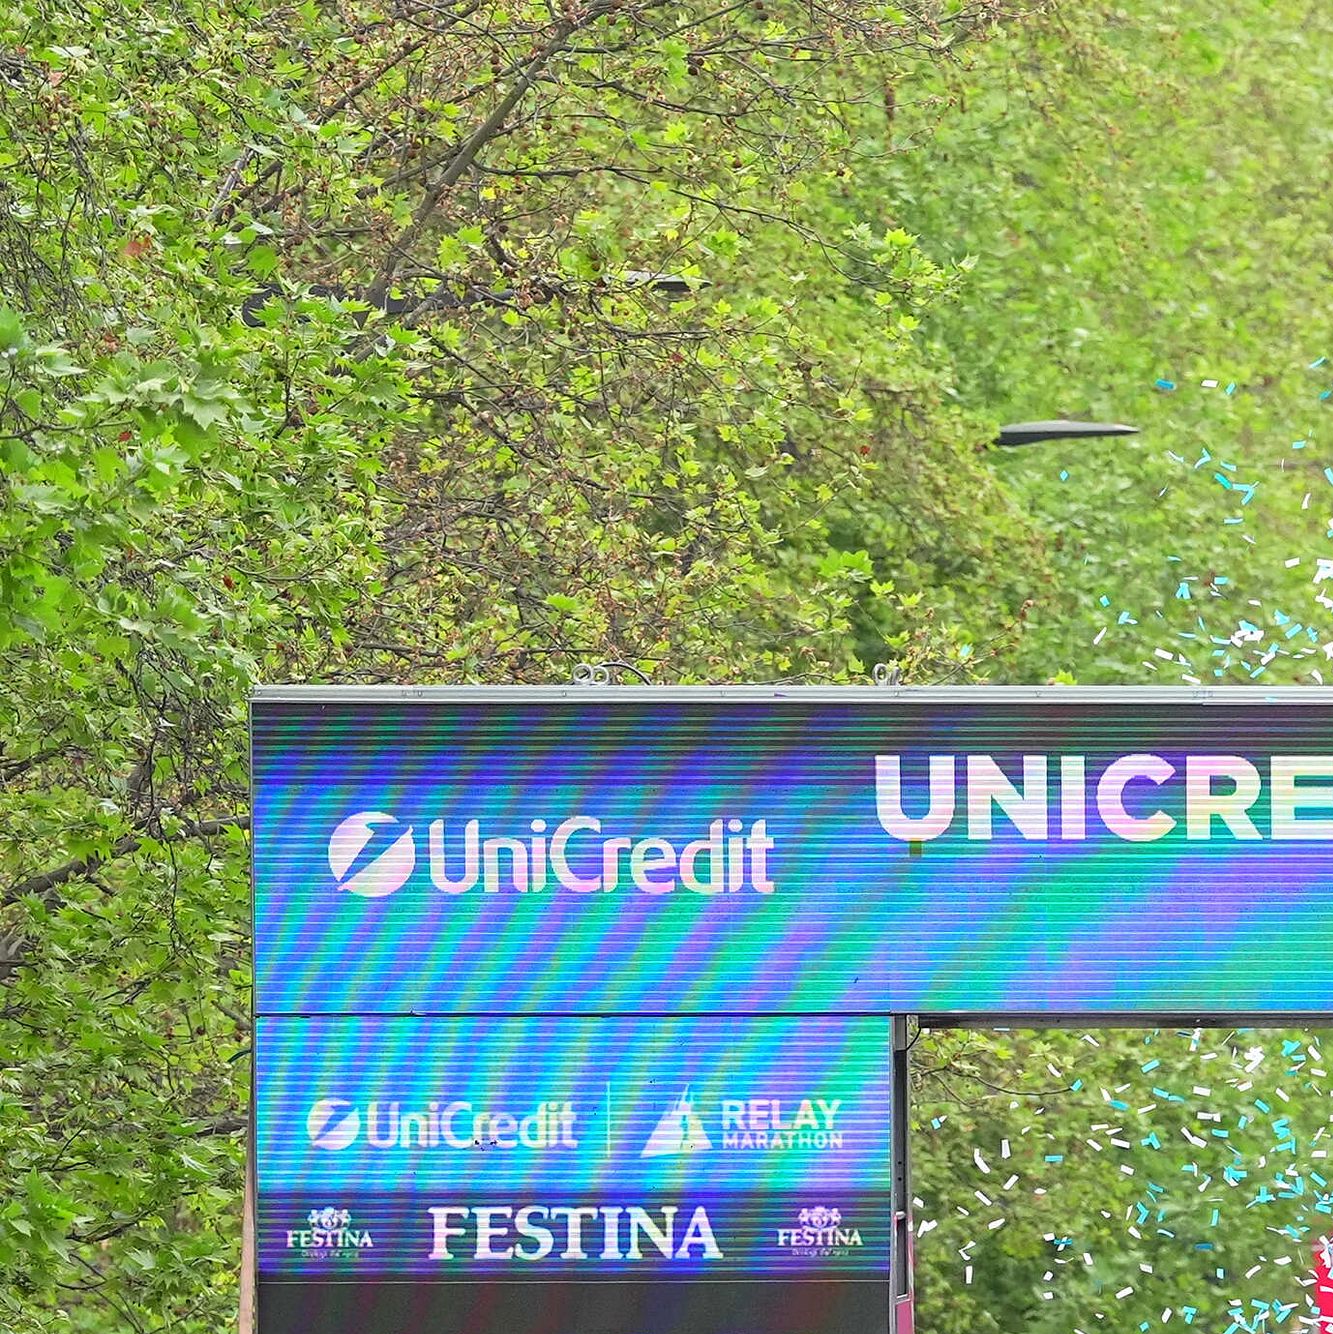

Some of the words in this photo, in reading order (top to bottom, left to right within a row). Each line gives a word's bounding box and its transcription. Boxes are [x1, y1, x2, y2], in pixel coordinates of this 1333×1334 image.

[430, 815, 776, 895] UniCredit
[367, 1098, 579, 1150] UniCredit
[722, 1099, 843, 1130] RELAY
[722, 1131, 844, 1150] MARATHON
[286, 1230, 374, 1248] FESTINA
[428, 1206, 724, 1261] FESTINA
[777, 1228, 864, 1246] FESTINA
